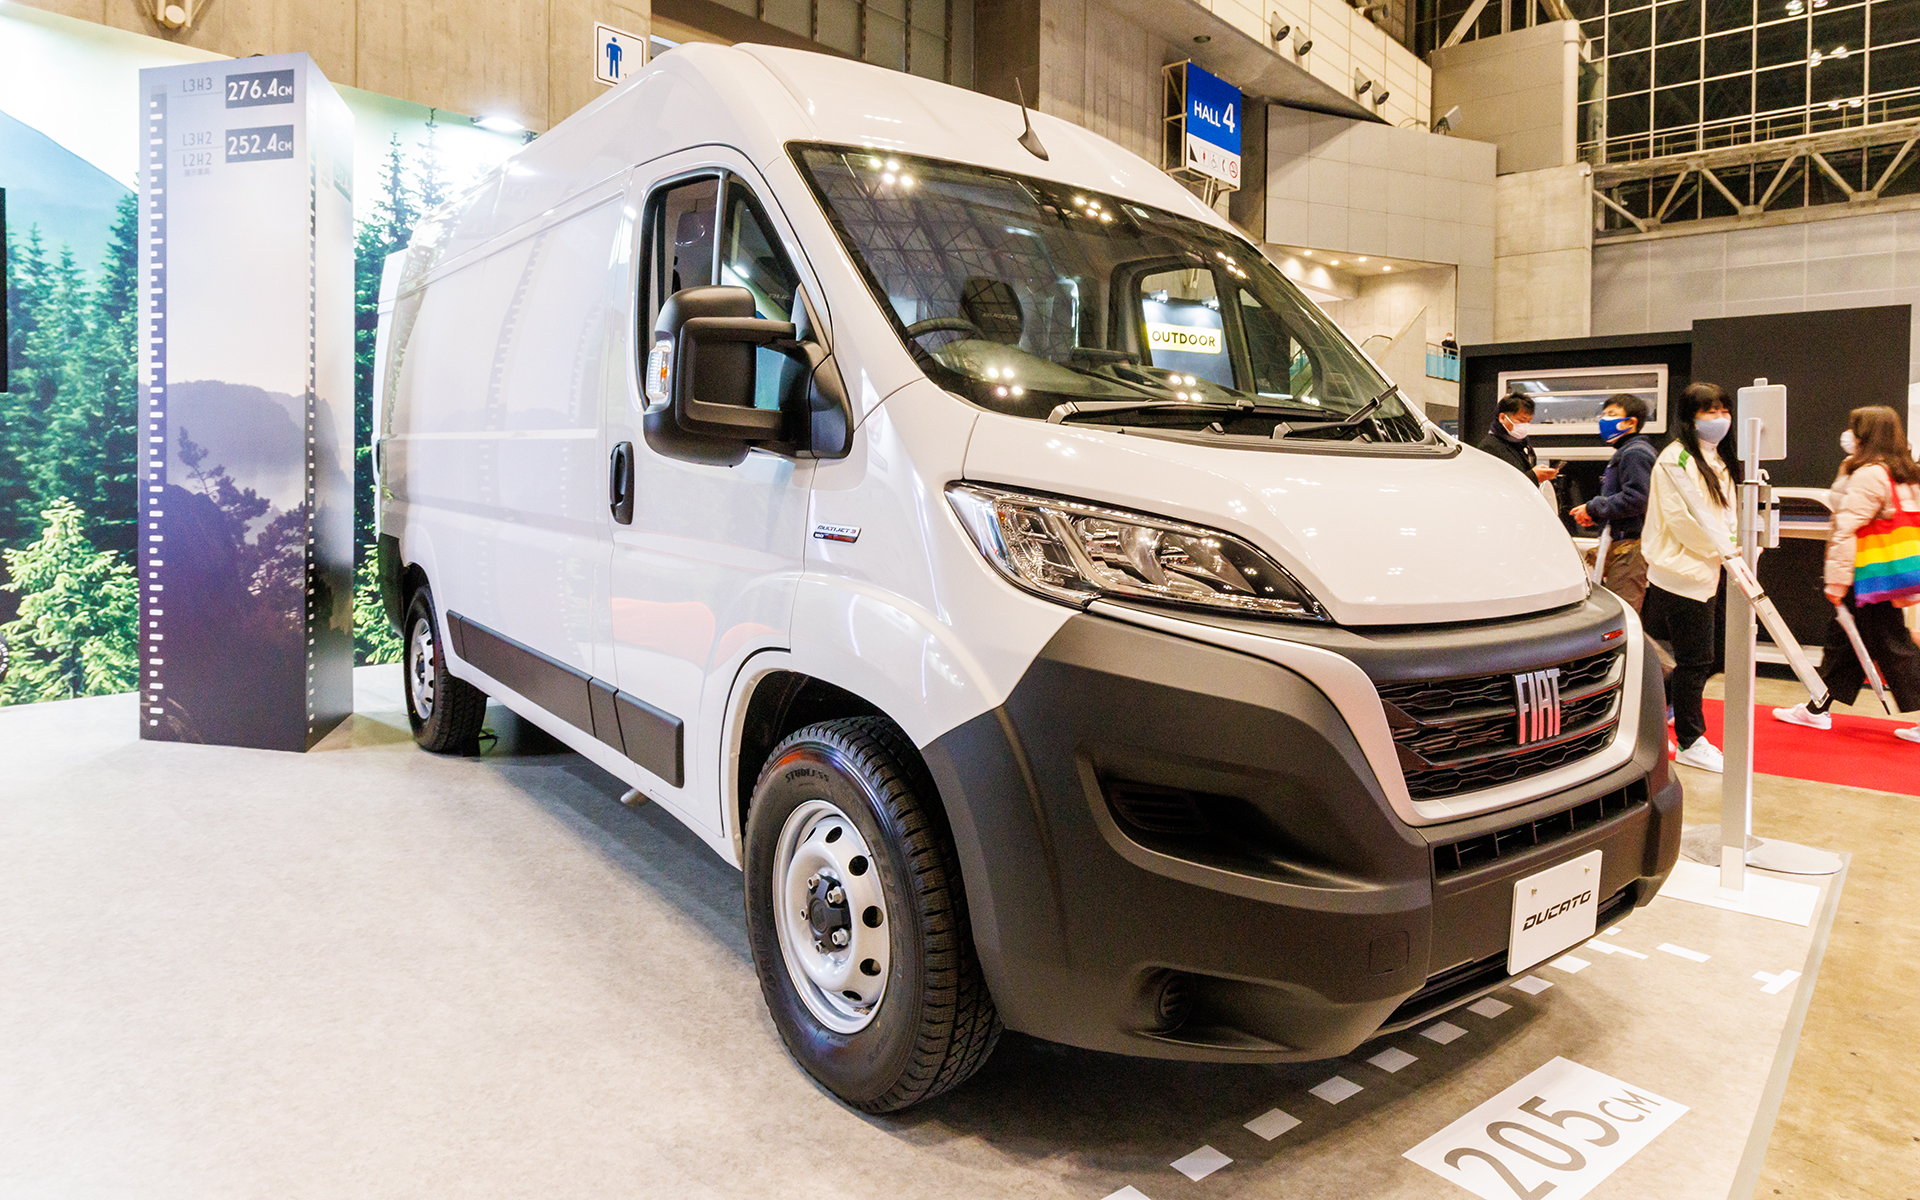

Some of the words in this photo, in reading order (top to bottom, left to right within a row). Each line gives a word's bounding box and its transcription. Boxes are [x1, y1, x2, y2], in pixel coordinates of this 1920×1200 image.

[182, 77, 213, 92] L3H3
[1194, 100, 1221, 128] HALL
[1222, 102, 1236, 134] 4
[182, 131, 212, 146] L3H2
[182, 152, 212, 167] L2H2
[1152, 330, 1216, 347] OUTDOOR
[1513, 667, 1561, 745] FIAT
[1522, 889, 1592, 932] DUCATO
